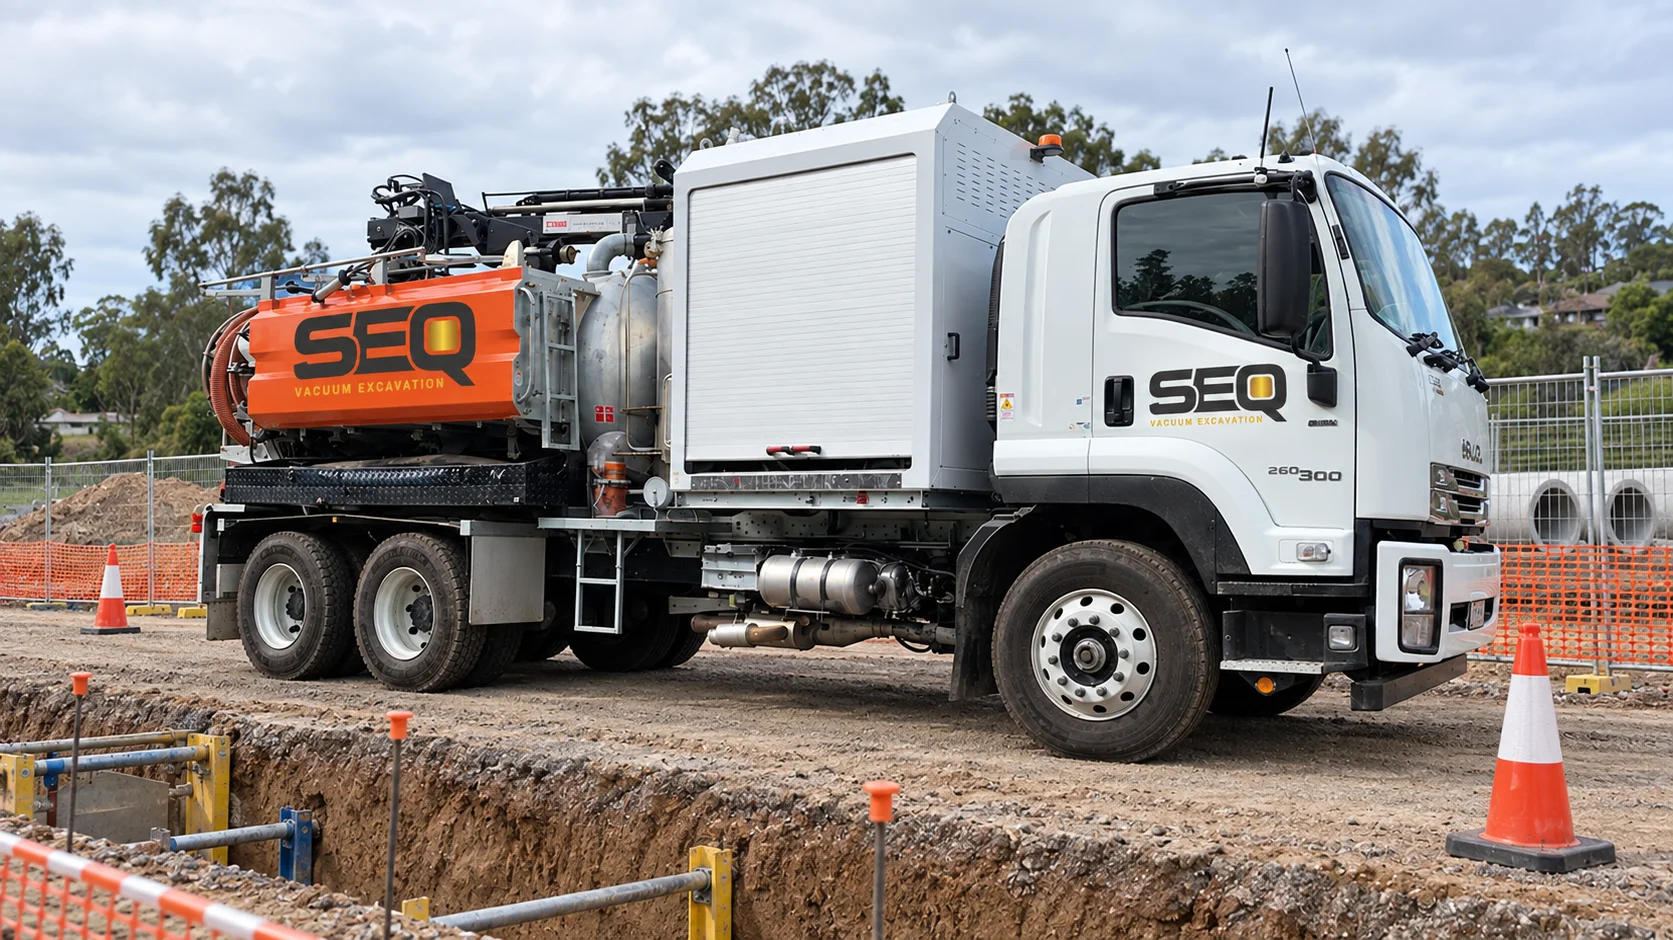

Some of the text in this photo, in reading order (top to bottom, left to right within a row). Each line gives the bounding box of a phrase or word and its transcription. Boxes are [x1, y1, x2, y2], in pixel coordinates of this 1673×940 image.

[294, 302, 475, 387] SEQ
[294, 378, 444, 397] VACUUM EXCAVATION
[1149, 364, 1286, 422] SEQ
[1149, 415, 1263, 427] VACUUM EXCAVATION
[1268, 466, 1342, 481] 260 300
